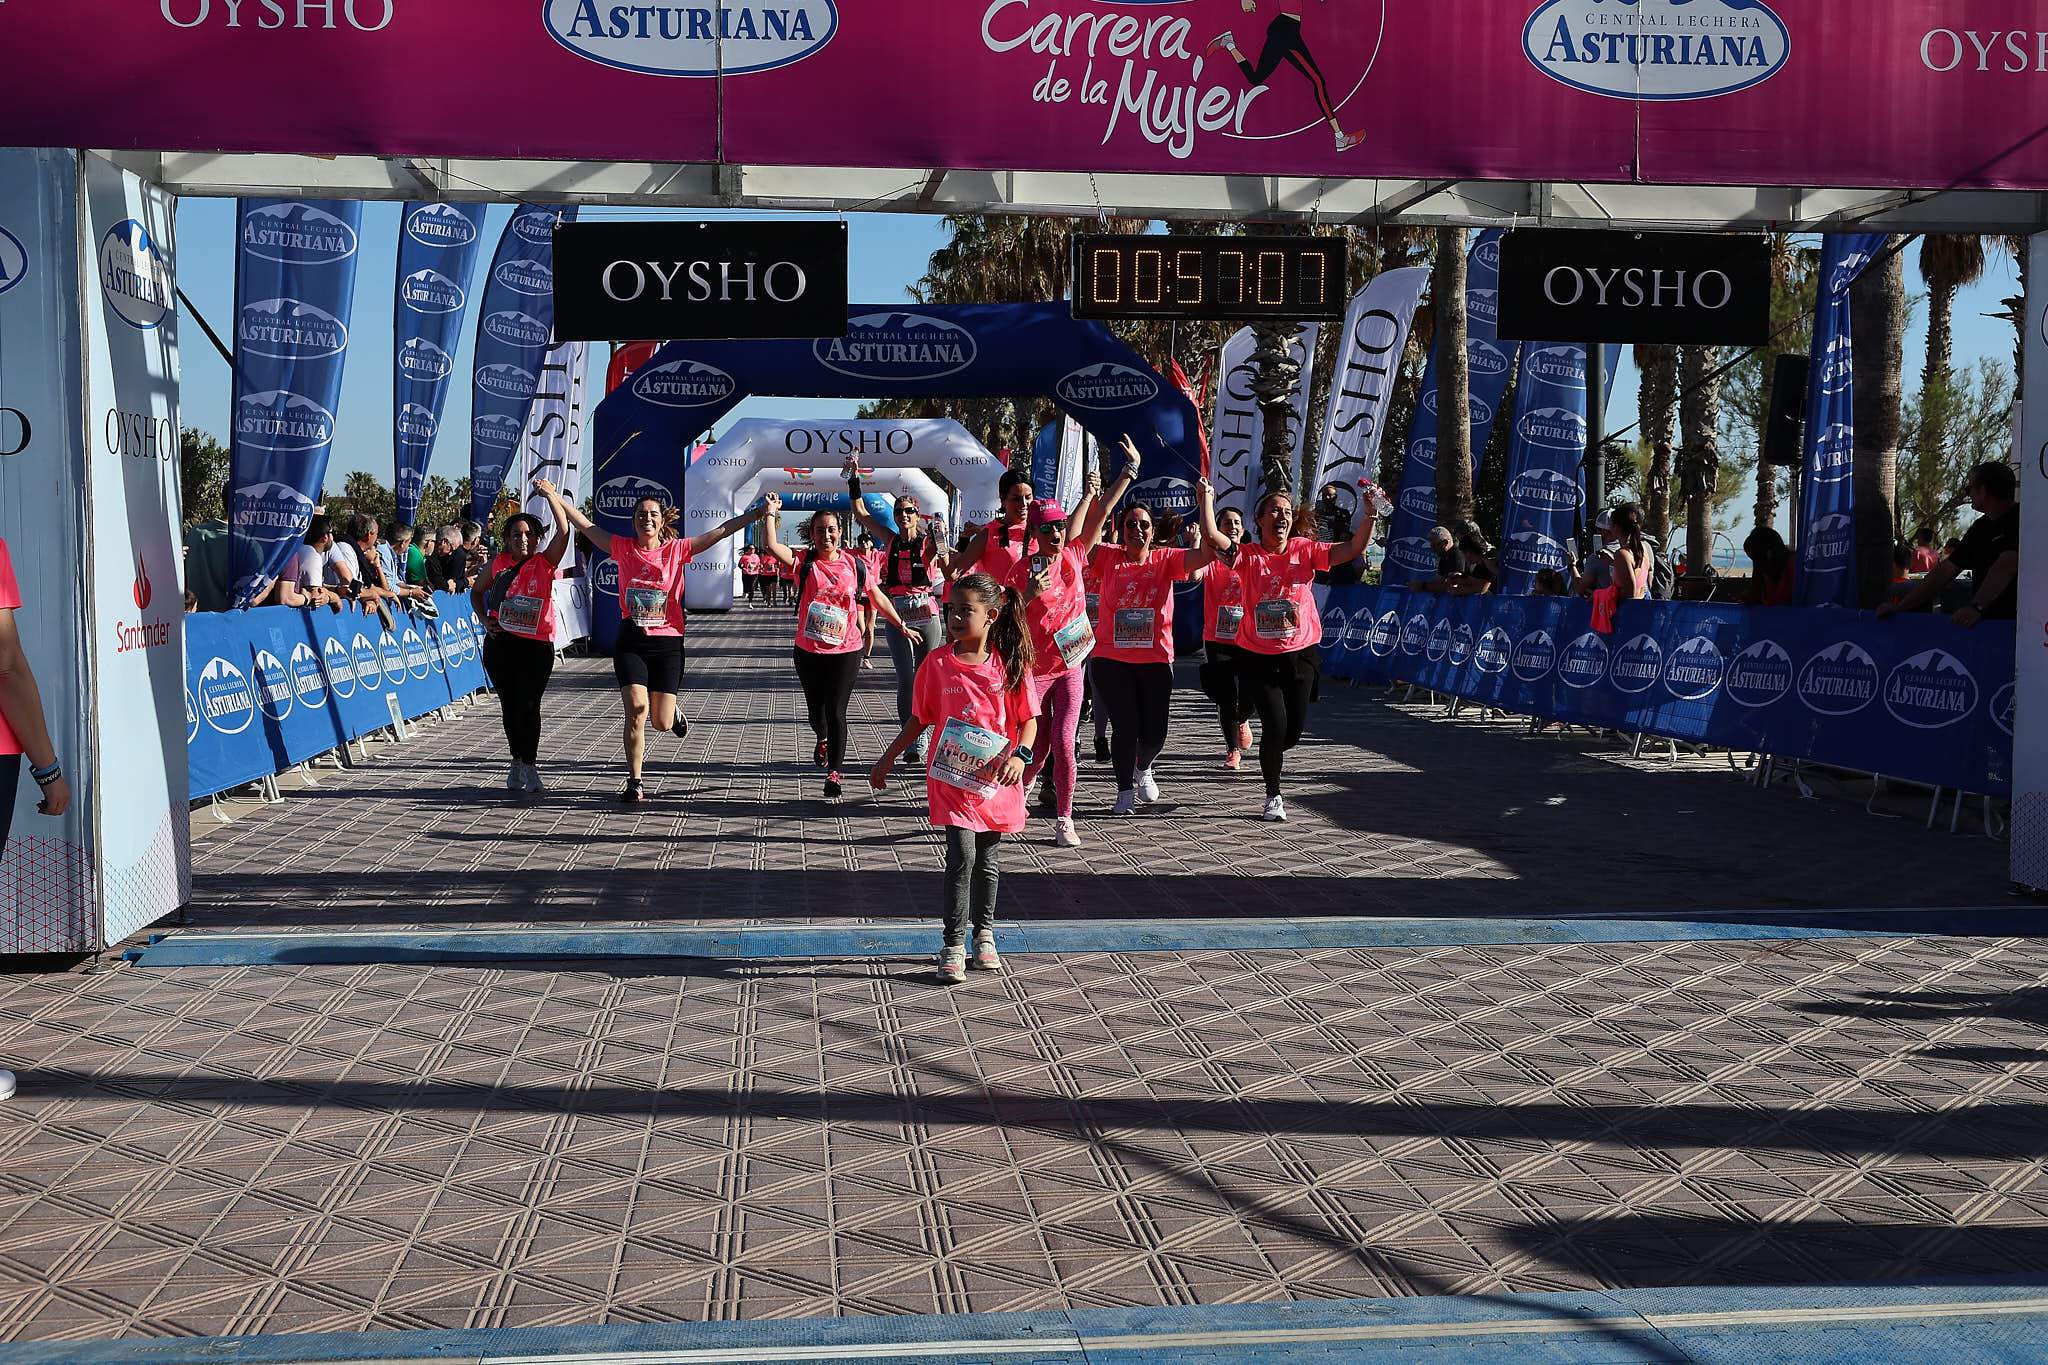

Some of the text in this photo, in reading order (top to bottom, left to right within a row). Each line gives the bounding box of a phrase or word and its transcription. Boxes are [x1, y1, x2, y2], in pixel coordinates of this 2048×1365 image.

[160, 0, 394, 31] OYSHO
[567, 0, 815, 41] ASTURIANA
[982, 0, 1191, 59] Carrera
[1586, 14, 1761, 28] CENTRAL LECHERA
[1543, 15, 1769, 66] ASTURIANA
[1032, 55, 1269, 159] de la Mujer
[245, 219, 347, 252] ASTURIANA
[411, 215, 468, 241] ASTURIANA
[602, 260, 806, 301] OYSHO
[1093, 249, 1325, 303] 00:57:07
[1543, 266, 1732, 309] OYSHO
[239, 316, 338, 348] ASTURIANA
[486, 318, 546, 343] ASTURIANA
[825, 336, 965, 363] ASTURIANA
[639, 376, 727, 396] ASTURIANA
[1064, 381, 1153, 399] ASTURIANA
[105, 408, 172, 462] OYSHO
[785, 428, 913, 454] OYSHO
[708, 457, 747, 467] OYSHO
[949, 456, 988, 466] OYSHO
[690, 509, 727, 519] OYSHO
[689, 562, 726, 571] OYSHO
[116, 617, 170, 653] Santander
[1666, 655, 1717, 686] ASTURIANA
[1729, 660, 1786, 692] ASTURIANA
[1802, 669, 1871, 700] ASTURIANA
[204, 688, 251, 719] ASTURIANA
[1888, 675, 1966, 713] ASTURIANA
